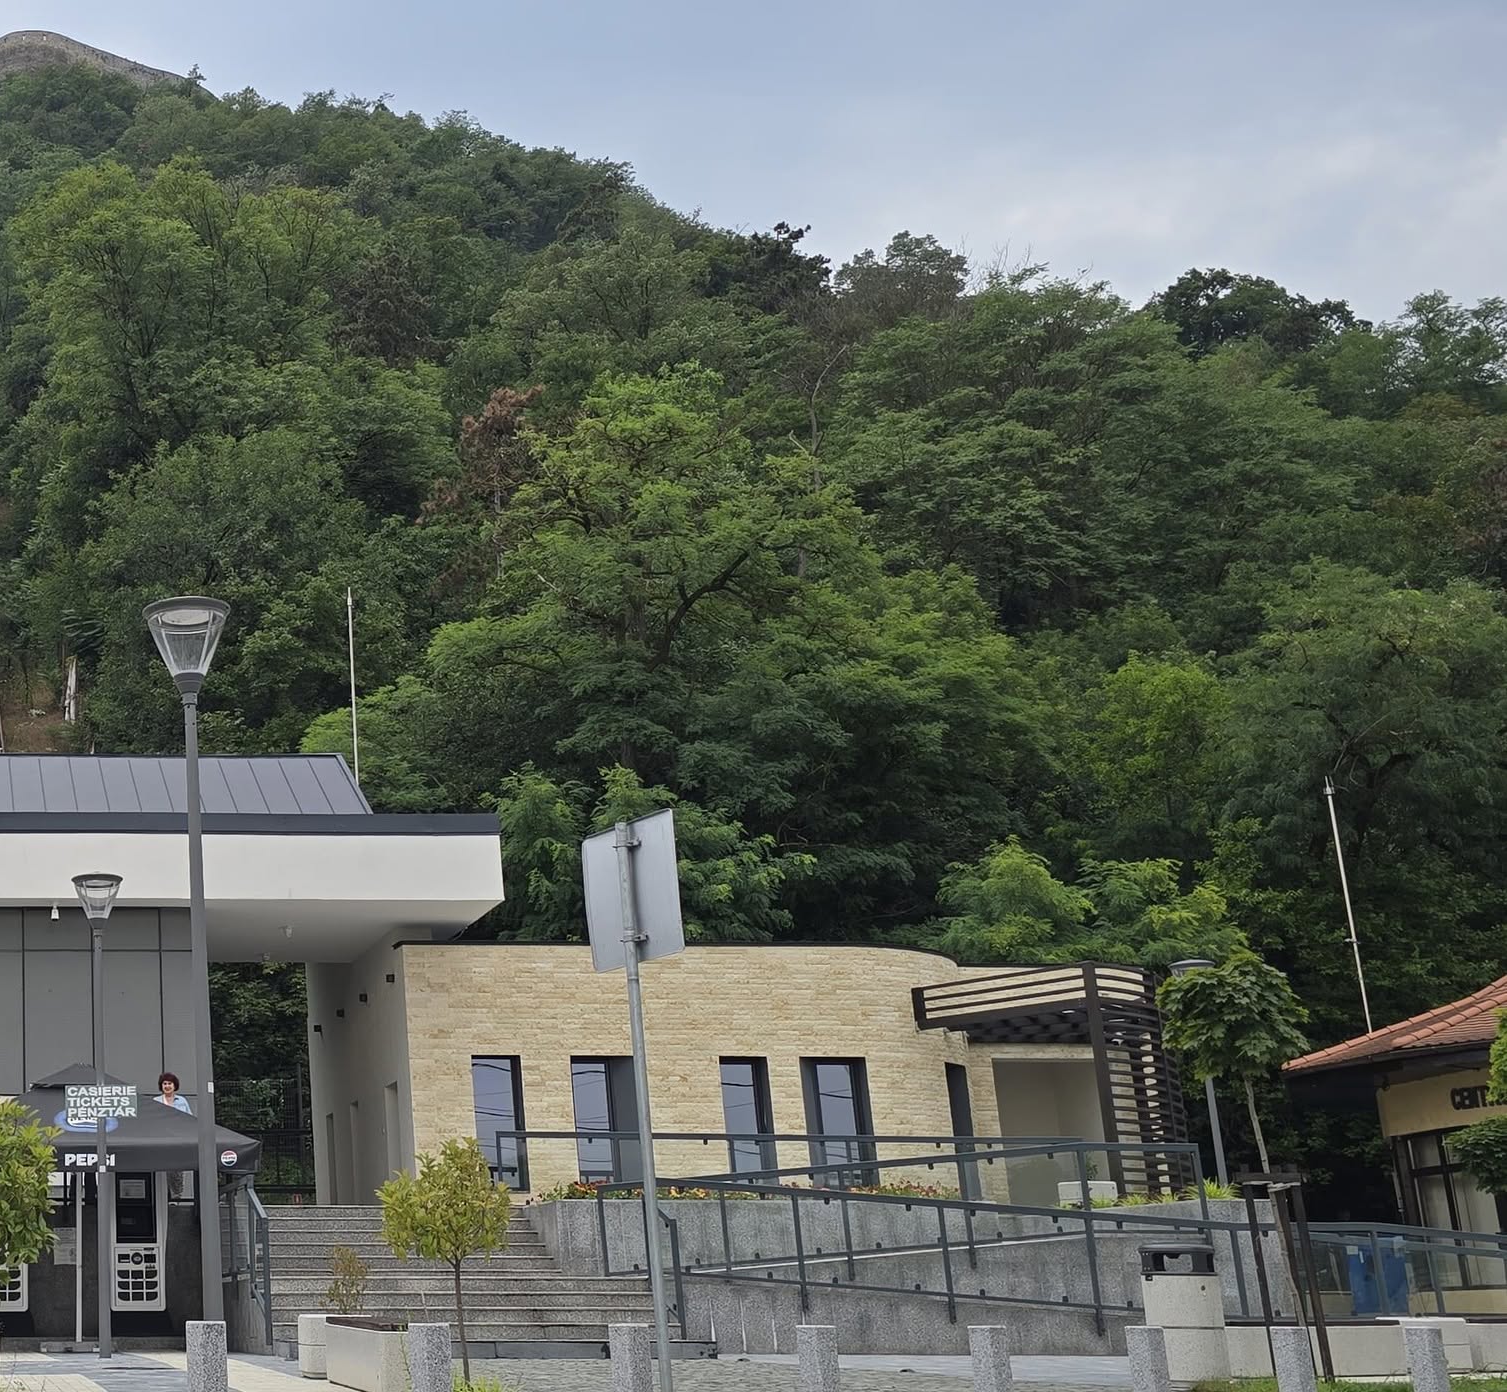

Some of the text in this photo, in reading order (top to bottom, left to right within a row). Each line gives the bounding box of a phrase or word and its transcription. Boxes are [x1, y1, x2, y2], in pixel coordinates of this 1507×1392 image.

[67, 1086, 137, 1096] CASIERIE
[67, 1097, 130, 1106] TICKETS
[67, 1106, 137, 1117] PÉNZTÁR
